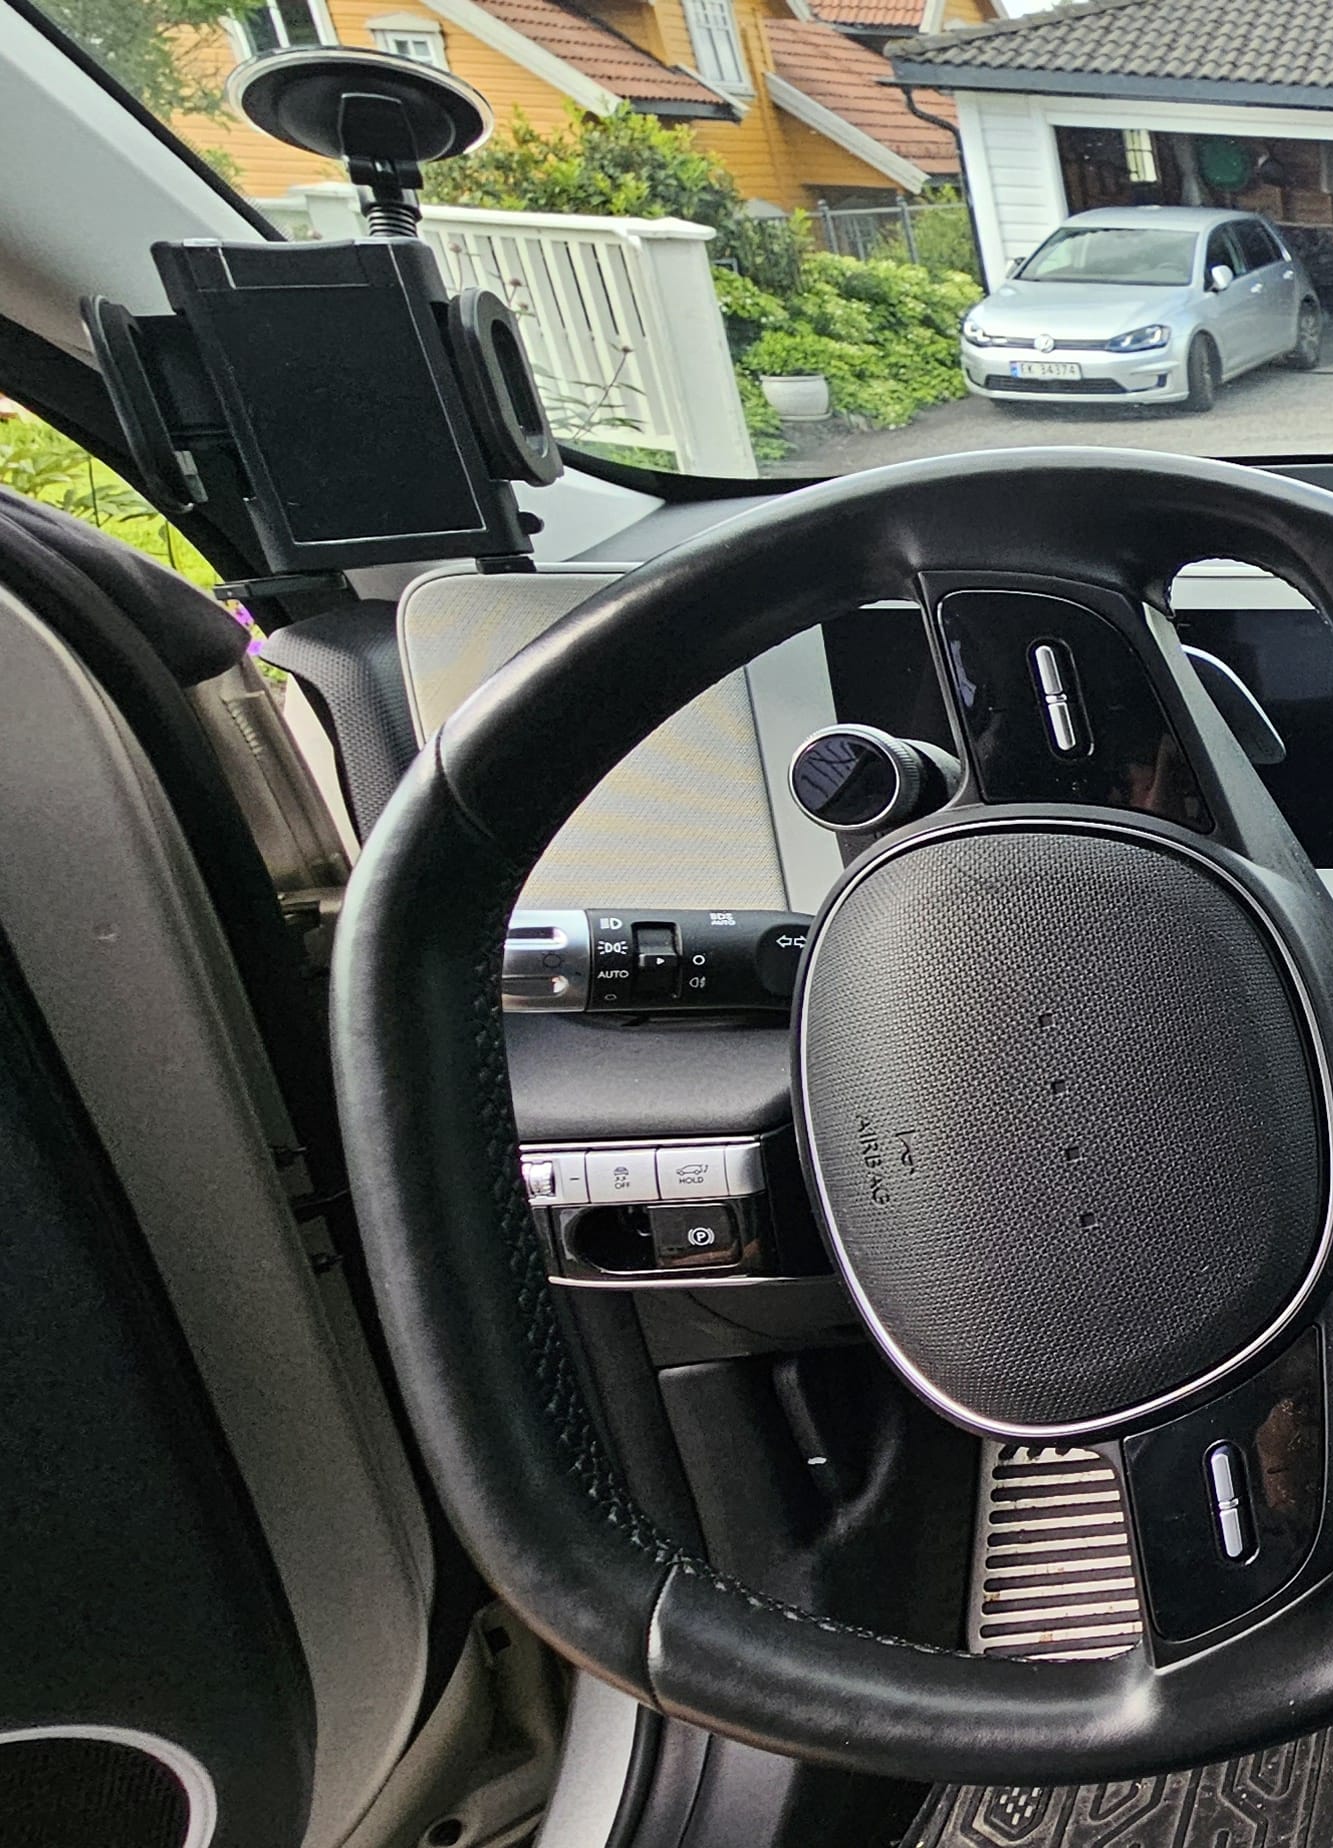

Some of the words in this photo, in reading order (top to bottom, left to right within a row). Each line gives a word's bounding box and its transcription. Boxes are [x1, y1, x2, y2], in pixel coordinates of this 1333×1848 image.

[597, 969, 629, 979] AUTO
[857, 1116, 890, 1206] AIRBAG
[614, 1182, 630, 1190] OFF
